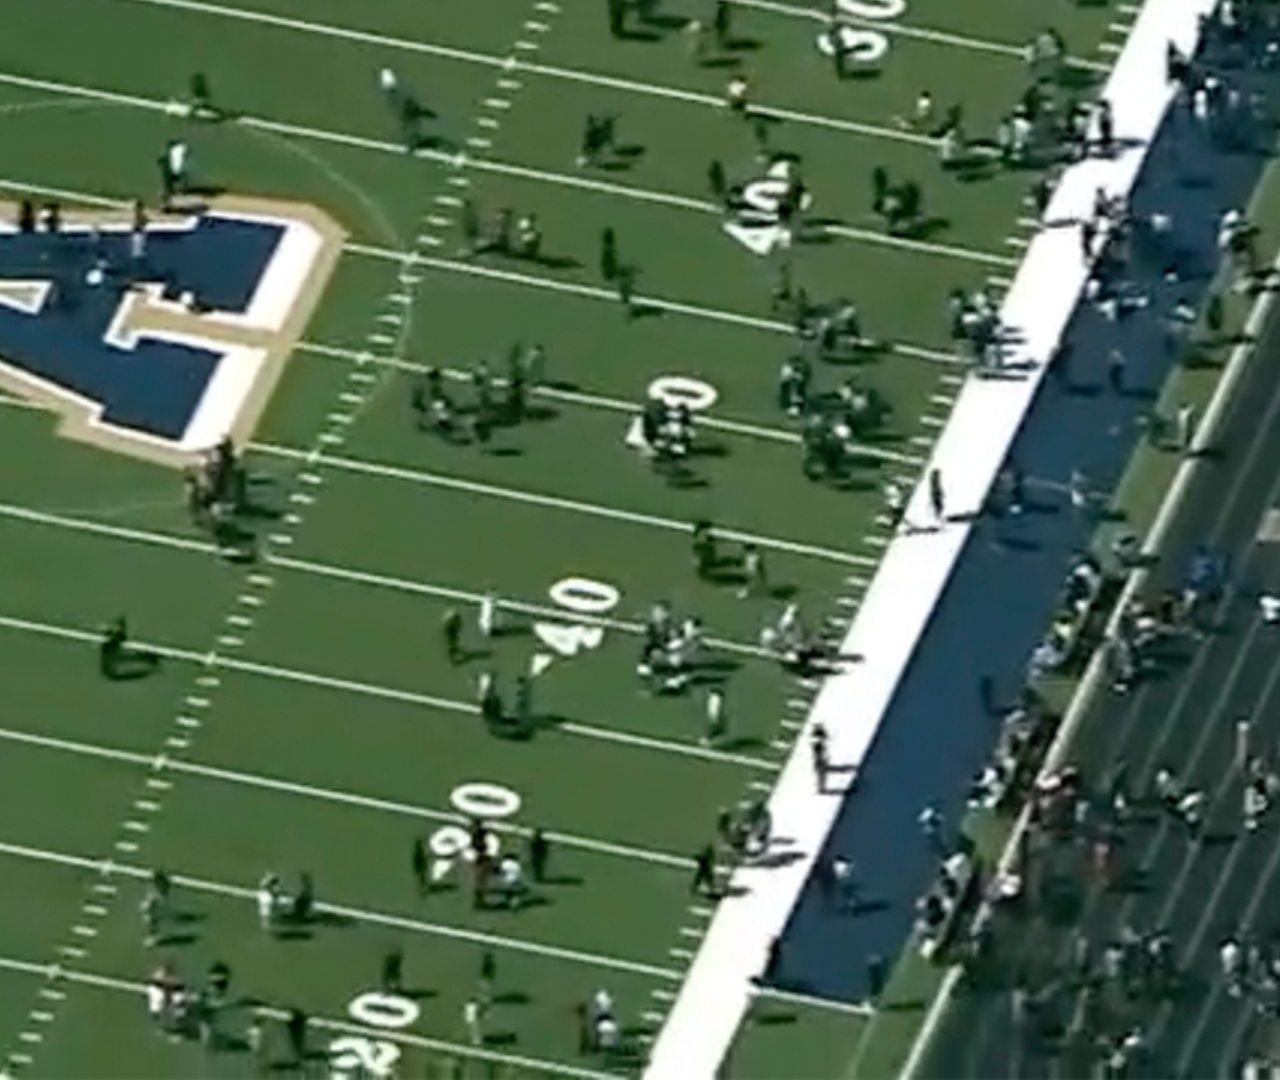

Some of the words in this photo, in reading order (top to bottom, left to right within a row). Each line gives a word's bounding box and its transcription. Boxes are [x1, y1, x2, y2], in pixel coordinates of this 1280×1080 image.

[625, 377, 718, 457] 0
[534, 578, 619, 655] 40
[330, 993, 419, 1077] 20
